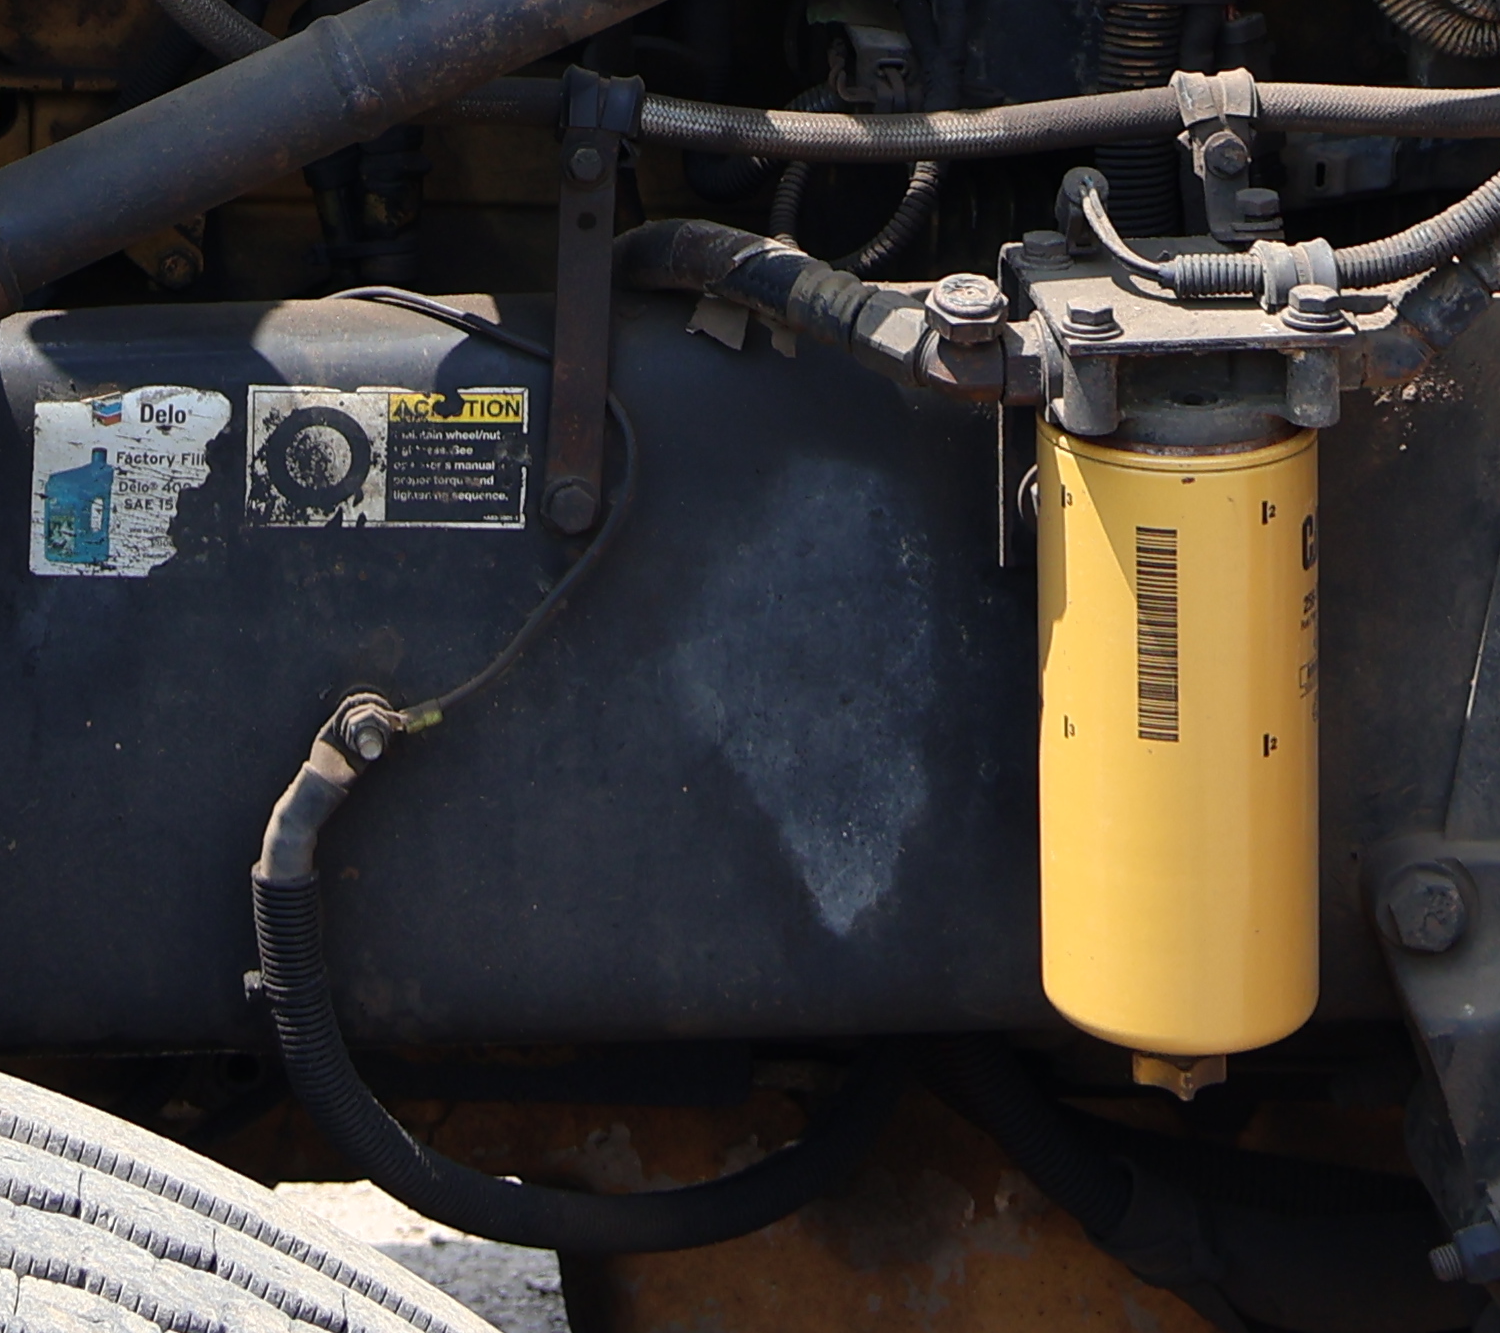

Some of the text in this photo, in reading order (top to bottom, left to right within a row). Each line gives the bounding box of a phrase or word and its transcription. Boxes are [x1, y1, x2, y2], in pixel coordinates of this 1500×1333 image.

[446, 429, 501, 440] wheel/nut
[116, 452, 175, 467] Factory
[454, 460, 495, 470] manual
[124, 498, 154, 510] SAE
